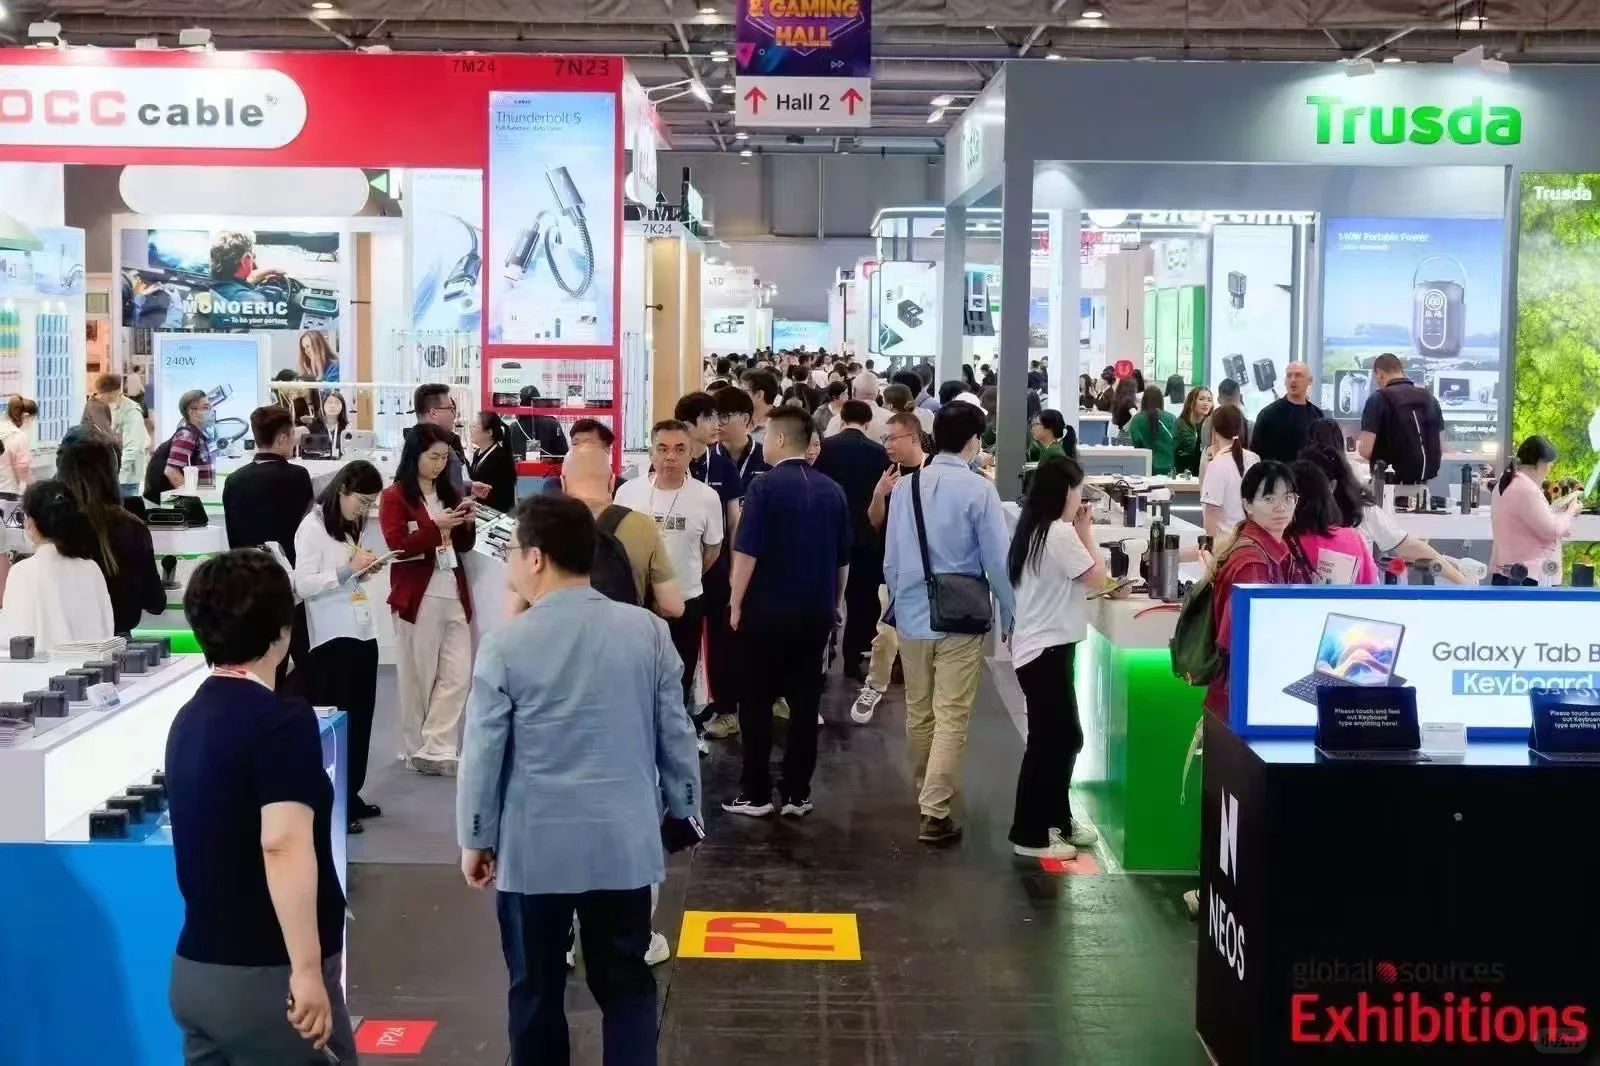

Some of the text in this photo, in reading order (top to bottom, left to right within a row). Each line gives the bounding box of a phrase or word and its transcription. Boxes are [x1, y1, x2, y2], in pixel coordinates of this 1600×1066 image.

[750, 0, 859, 17] & GAMING
[776, 26, 832, 46] HALL
[452, 60, 496, 73] 7M24
[554, 59, 609, 76] 7N23
[776, 94, 830, 110] Hall 2
[138, 98, 264, 127] cable
[496, 112, 581, 124] Thunderbolt 5
[1306, 96, 1521, 145] Trusda
[1533, 183, 1592, 200] Trusda
[642, 224, 672, 235] 7K24
[183, 300, 288, 315] MONOERIC
[166, 357, 196, 366] 240W
[1433, 642, 1526, 669] Galaxy
[1535, 643, 1581, 662] Tab
[1463, 672, 1593, 695] Keyboard
[703, 916, 835, 953] 7P
[1209, 881, 1245, 981] NEOS
